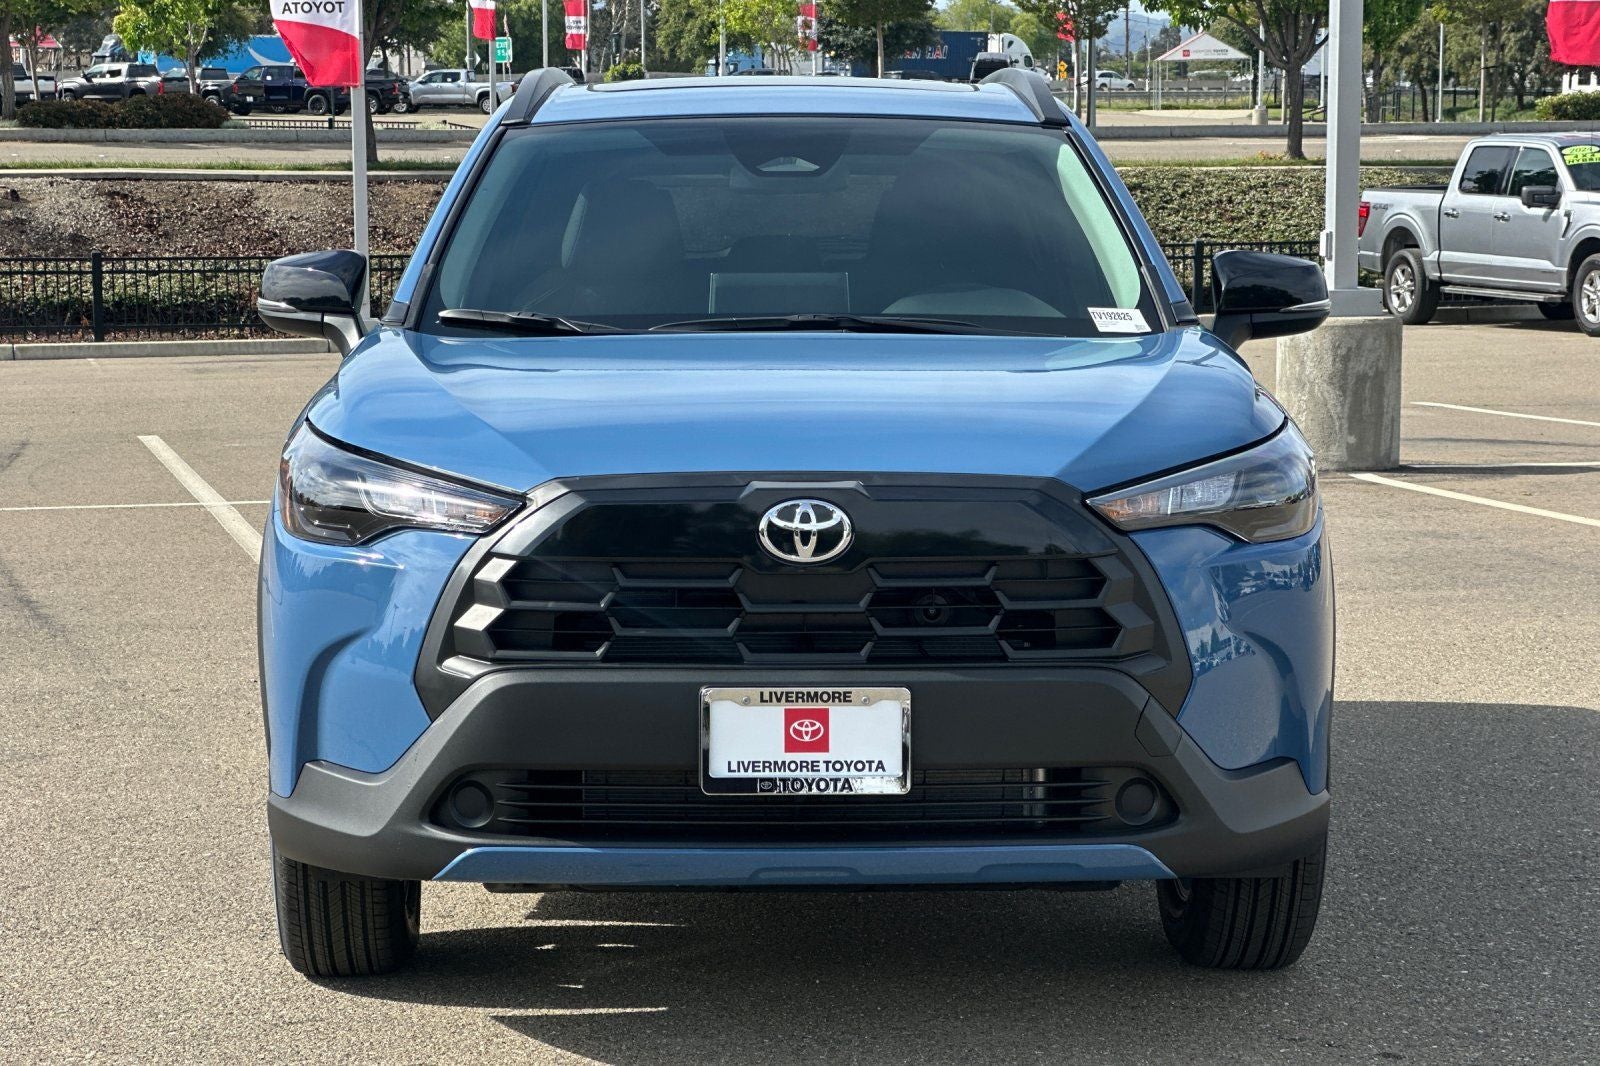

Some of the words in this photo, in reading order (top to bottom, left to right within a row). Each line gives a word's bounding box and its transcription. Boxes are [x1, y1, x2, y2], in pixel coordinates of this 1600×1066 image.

[1091, 311, 1133, 321] TV192825
[759, 691, 853, 703] LIVERMORE
[727, 760, 820, 773] LIVERMORE
[824, 760, 886, 773] TOYOTA
[777, 778, 853, 793] TOYOTA
